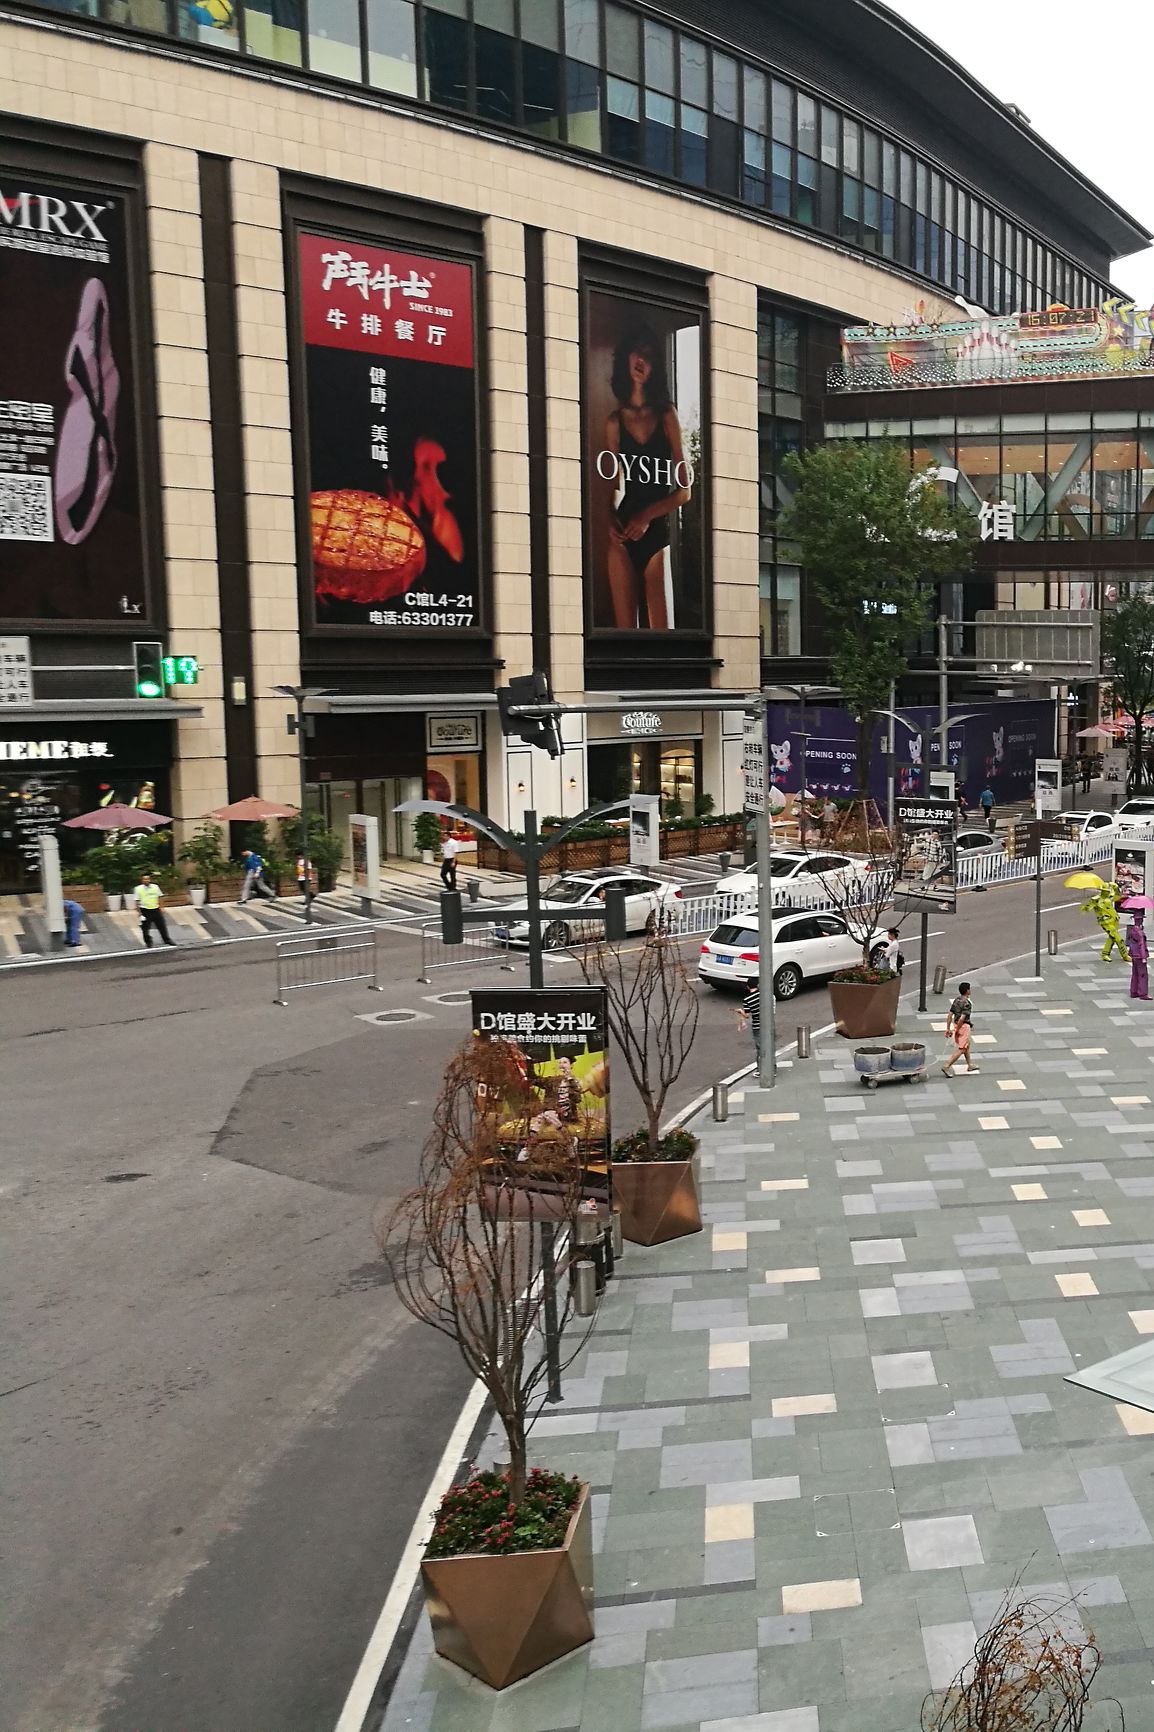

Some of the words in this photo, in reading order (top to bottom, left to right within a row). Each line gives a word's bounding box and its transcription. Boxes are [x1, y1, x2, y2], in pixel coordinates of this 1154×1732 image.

[409, 302, 434, 314] SINCE
[435, 307, 454, 317] 1983
[326, 308, 447, 346] 牛排餐厅
[597, 450, 695, 490] OYSHO
[405, 592, 473, 608] C馆L4-21
[369, 610, 474, 627] 电话:63301377
[800, 750, 834, 759] PENING
[899, 807, 954, 819] D馆盛大开业
[480, 1012, 597, 1031] D馆盛大开业
